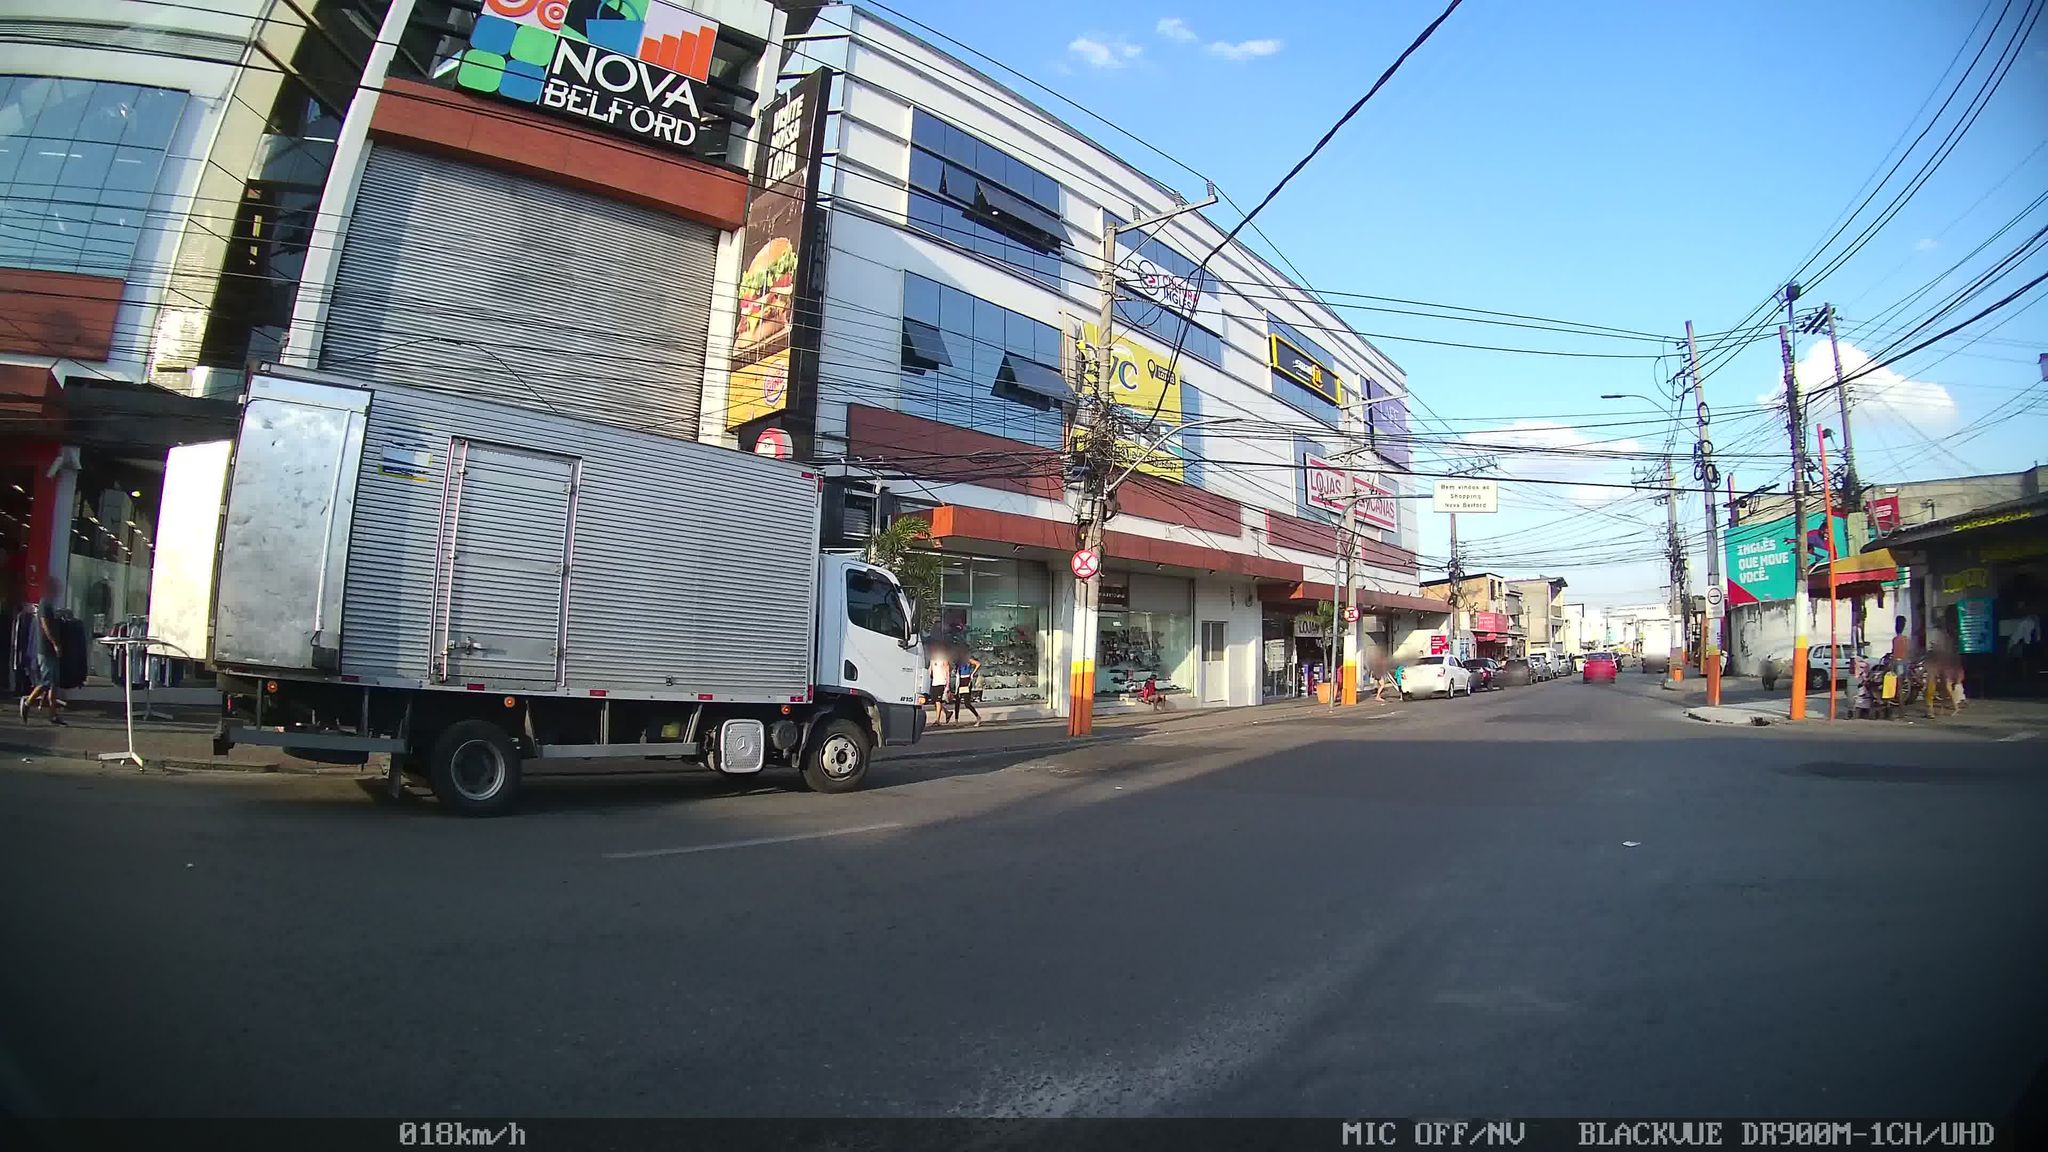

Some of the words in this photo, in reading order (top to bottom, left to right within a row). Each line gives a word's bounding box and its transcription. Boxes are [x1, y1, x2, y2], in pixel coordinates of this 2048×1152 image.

[552, 38, 701, 119] NOVA
[544, 77, 697, 146] BELFORD
[1310, 469, 1342, 495] LOJAS
[1737, 537, 1777, 556] INGLÊS
[1738, 556, 1760, 571] QUE
[1760, 551, 1790, 567] MOVE
[1739, 566, 1770, 584] VOCÊ.
